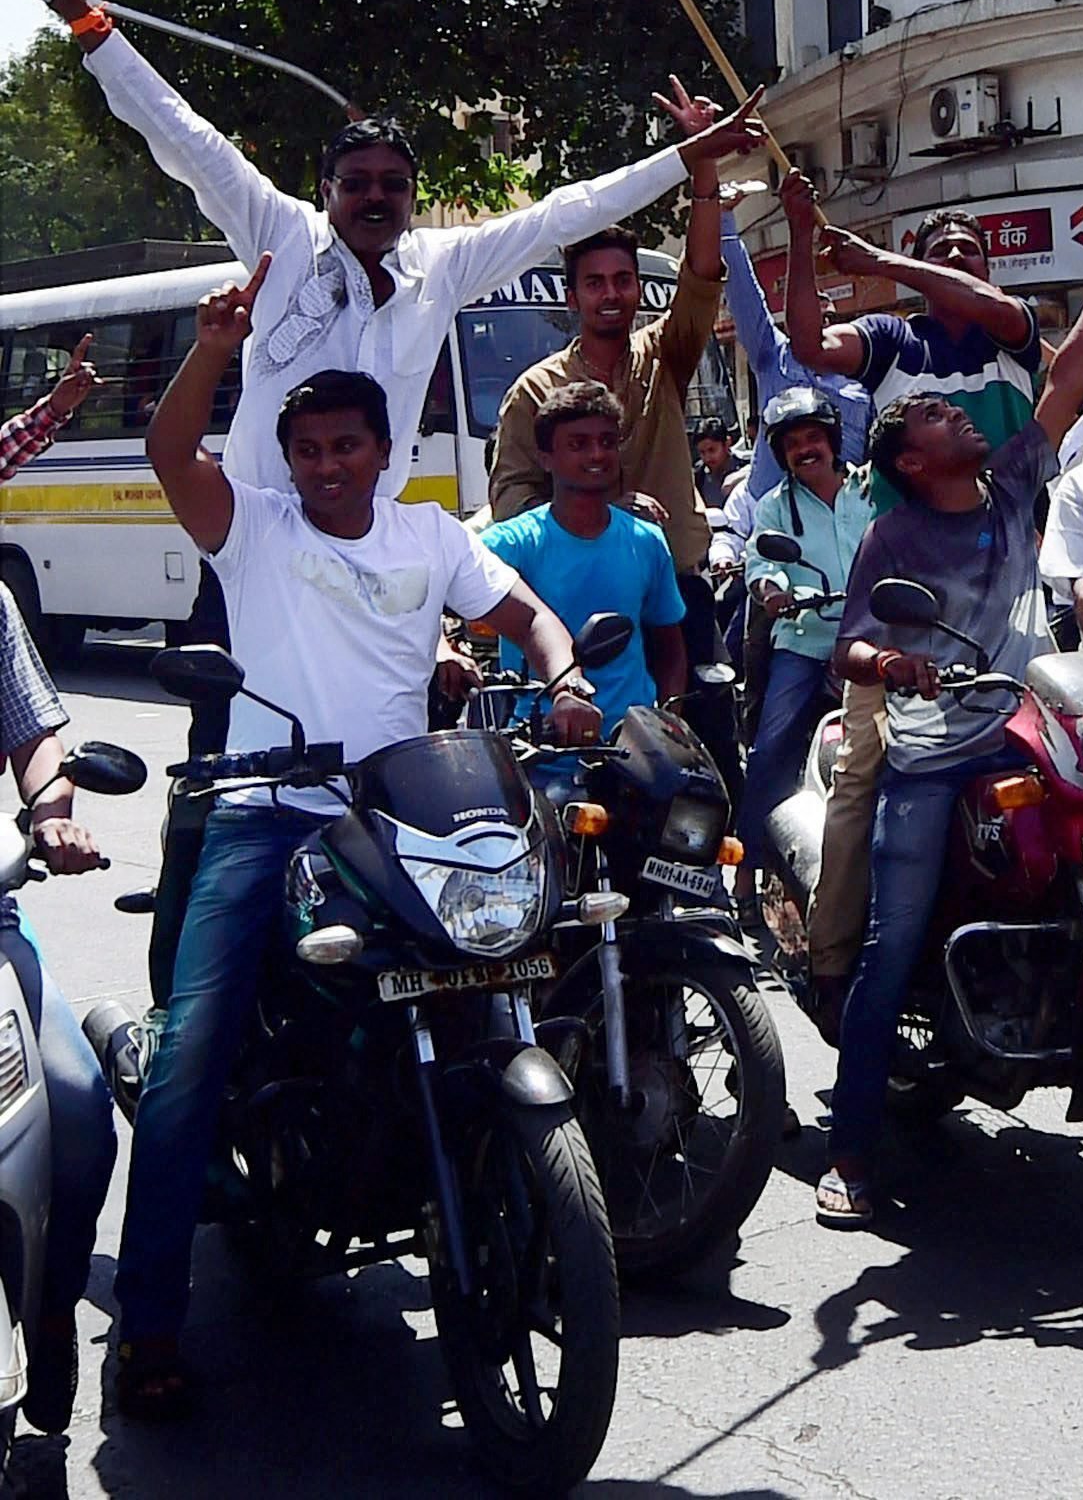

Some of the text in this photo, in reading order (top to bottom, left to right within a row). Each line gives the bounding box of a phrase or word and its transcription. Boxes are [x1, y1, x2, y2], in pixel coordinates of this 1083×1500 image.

[452, 807, 508, 823] HONDA
[977, 824, 1000, 841] TVS
[392, 972, 424, 995] MH
[509, 957, 550, 979] 1056
